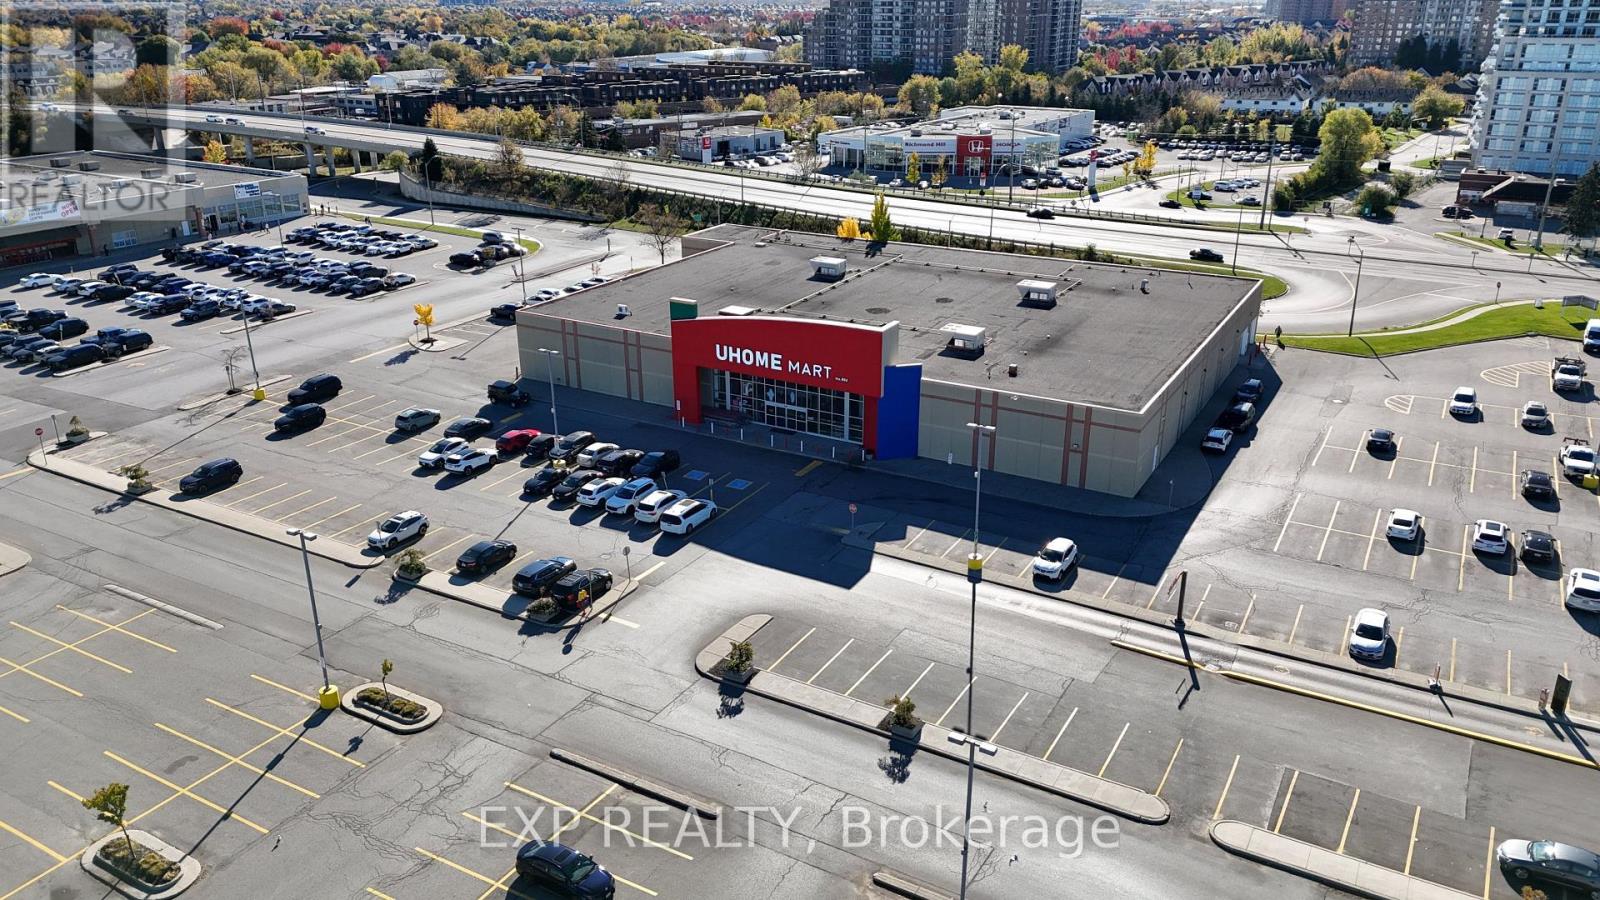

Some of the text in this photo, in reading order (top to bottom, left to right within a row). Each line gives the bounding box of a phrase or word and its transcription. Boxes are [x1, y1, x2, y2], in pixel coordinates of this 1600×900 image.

[61, 205, 79, 217] OPEN
[714, 343, 832, 379] UHOME MART
